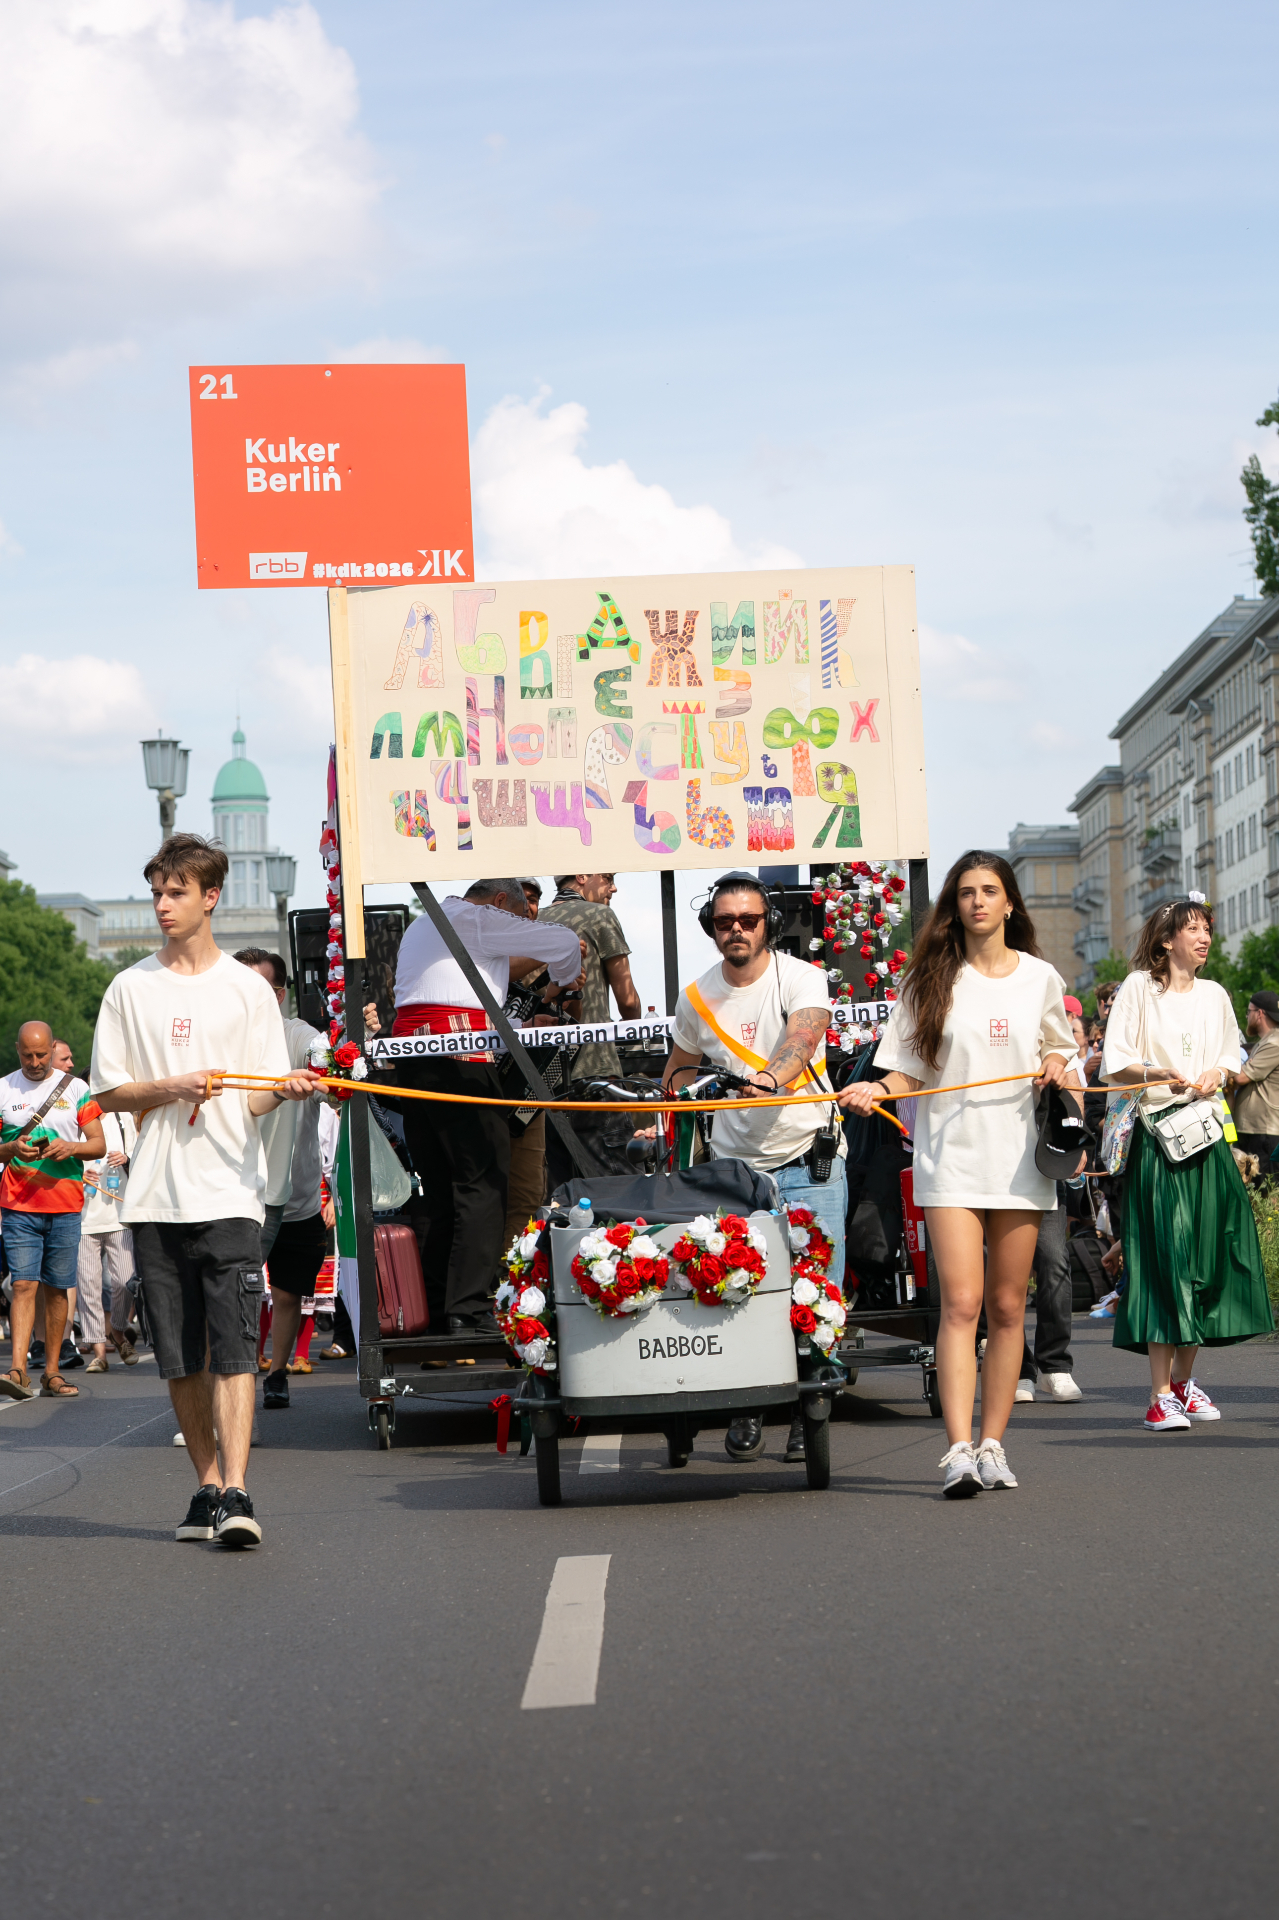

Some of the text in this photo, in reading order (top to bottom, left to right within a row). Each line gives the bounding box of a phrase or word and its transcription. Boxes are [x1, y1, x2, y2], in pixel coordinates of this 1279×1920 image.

[199, 374, 238, 399] 21
[245, 437, 340, 463] Kuker
[247, 466, 342, 492] Berlin
[255, 558, 299, 574] rbb
[312, 562, 414, 578] #kdk2026
[374, 1033, 501, 1057] Association
[514, 1026, 608, 1047] ulgarian
[851, 1004, 870, 1021] in
[638, 1334, 723, 1360] BABBOE
